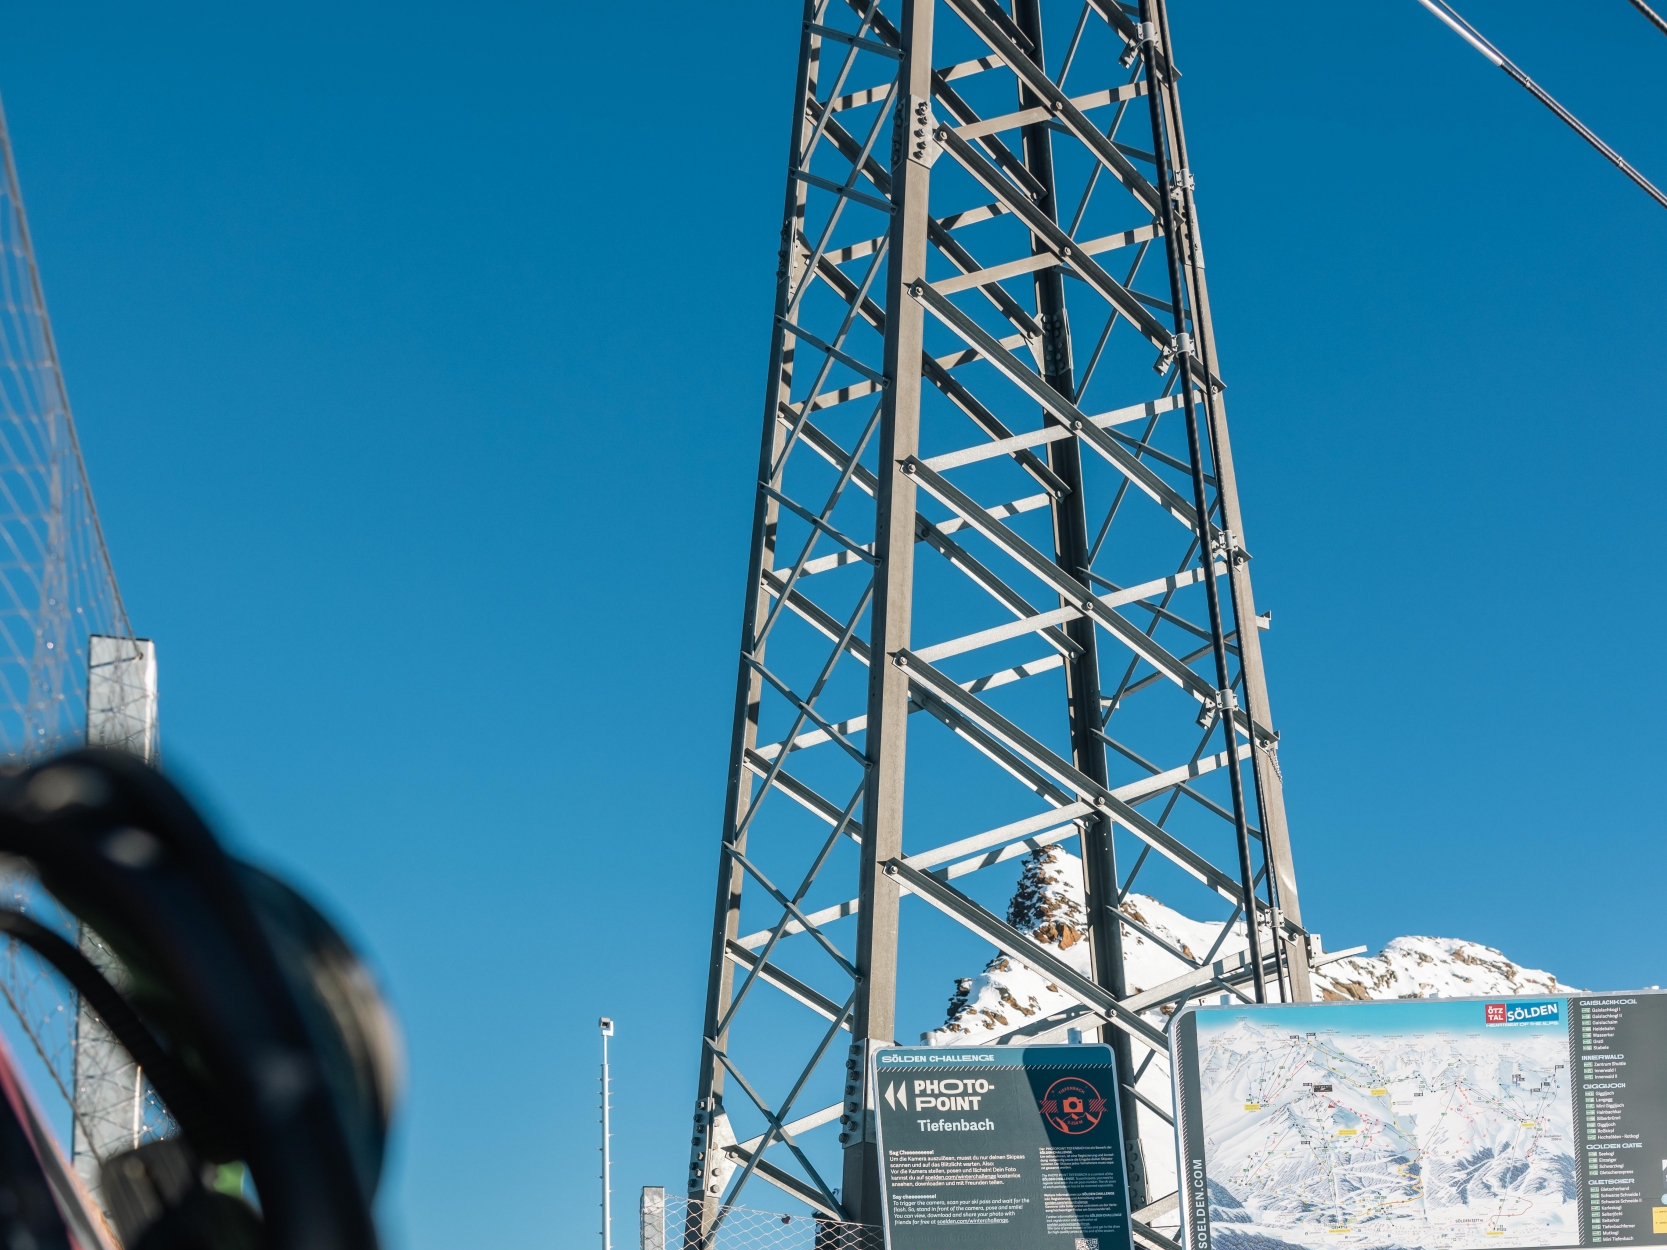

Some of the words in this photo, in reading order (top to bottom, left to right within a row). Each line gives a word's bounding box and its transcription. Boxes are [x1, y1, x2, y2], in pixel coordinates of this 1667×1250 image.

[1507, 1004, 1558, 1021] SÖLDEN
[882, 1054, 926, 1062] SÖLDEN
[914, 1079, 994, 1094] PHOTO-
[916, 1096, 981, 1111] POINT
[917, 1118, 994, 1131] Tiefenbach
[1193, 1160, 1207, 1249] SOELDEN.COM
